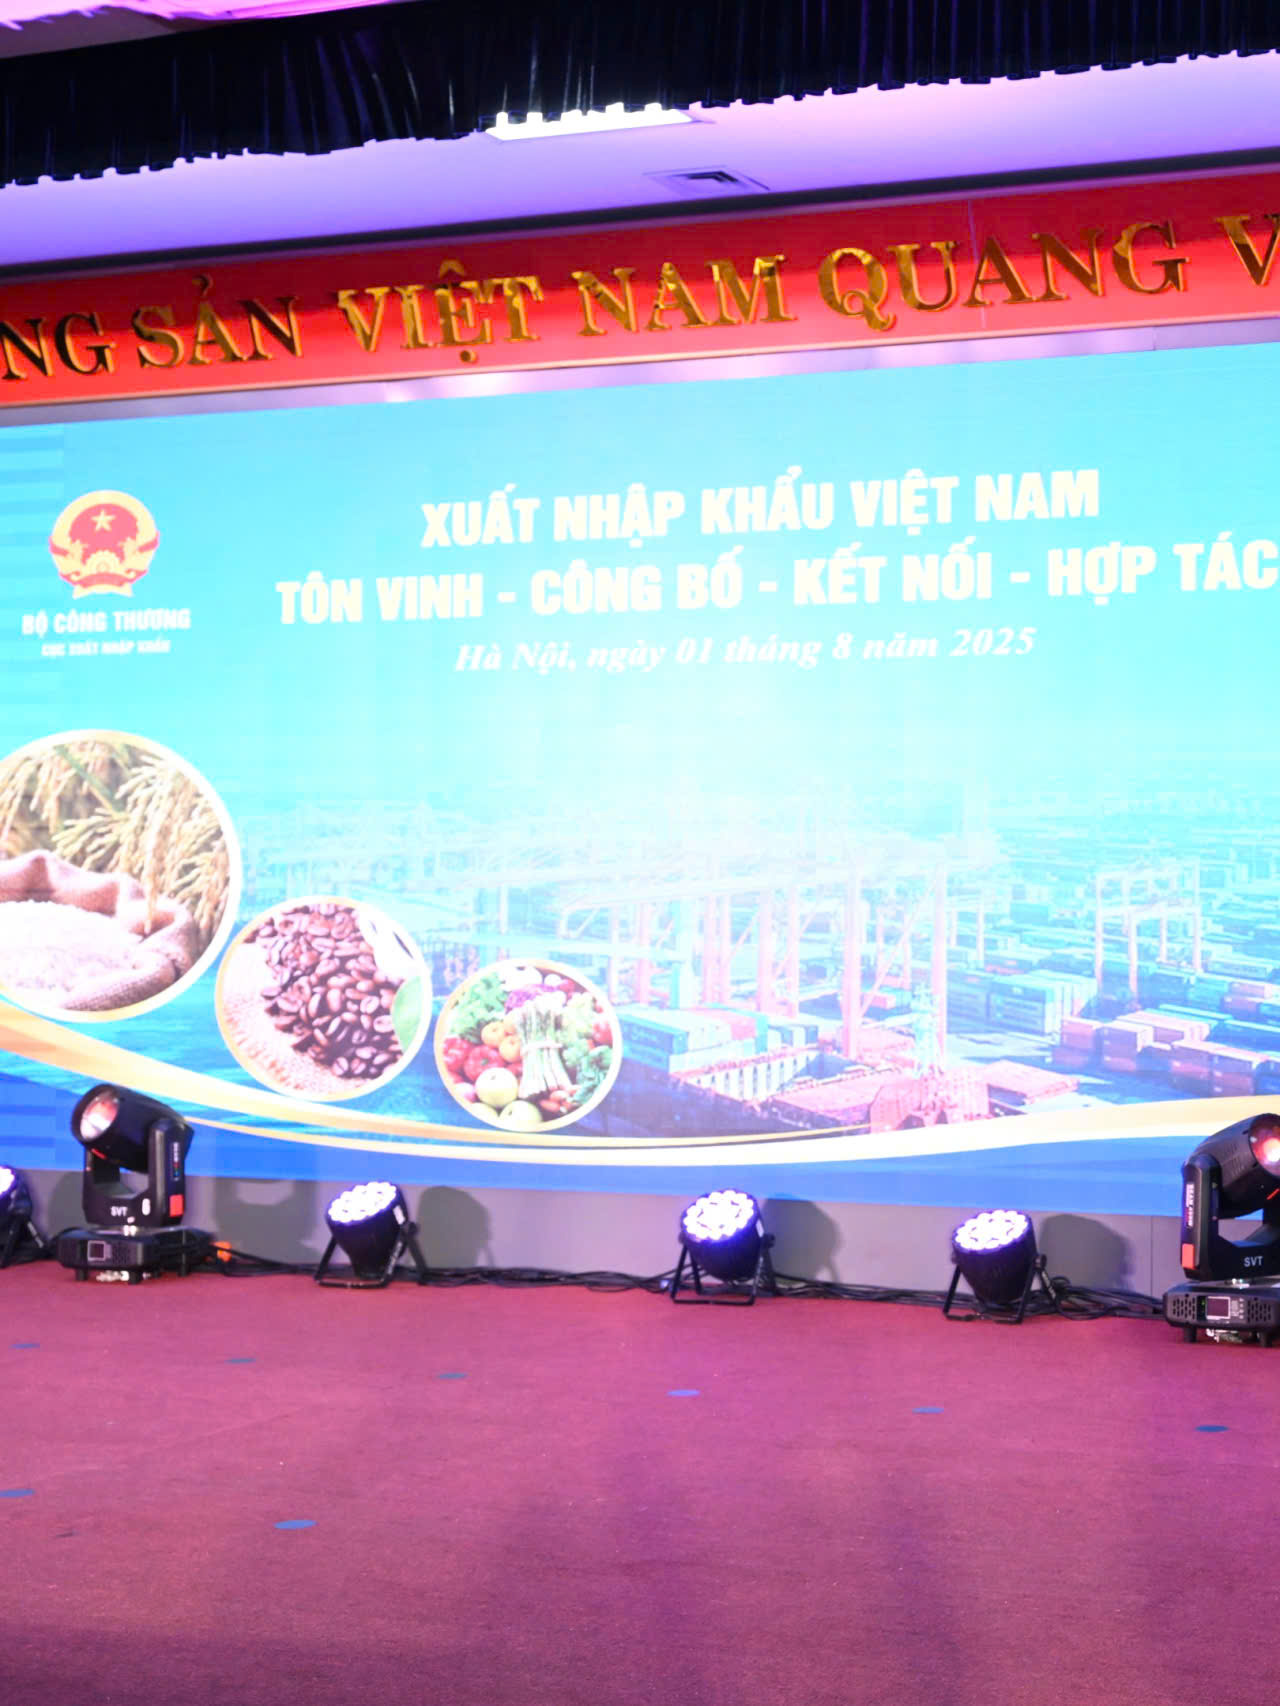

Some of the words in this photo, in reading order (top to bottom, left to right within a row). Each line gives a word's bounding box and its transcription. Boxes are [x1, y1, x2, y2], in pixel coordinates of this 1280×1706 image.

[134, 273, 303, 369] SẢN
[337, 258, 543, 364] VIỆT
[571, 253, 797, 337] NAM
[816, 218, 1191, 332] QUANG
[420, 482, 540, 548] XUẤT
[553, 481, 686, 548] NHẬP
[701, 464, 835, 536] KHẨU
[850, 467, 960, 536] VIỆT
[975, 468, 1100, 522] NAM
[275, 570, 363, 625] TÔN
[376, 573, 484, 621] VINH
[497, 591, 517, 603] -
[530, 558, 663, 616] CÔNG
[676, 545, 745, 610] BỐ
[758, 579, 778, 592] -
[793, 541, 888, 606] KẾT
[902, 535, 993, 602] NỐI
[1009, 571, 1031, 584] -
[1047, 540, 1157, 606] HỢP
[1172, 530, 1280, 592] TÁC
[53, 608, 108, 633] CÔNG
[455, 642, 502, 672] Hà
[511, 639, 577, 675] Nội,
[585, 639, 667, 673] ngày
[675, 635, 714, 664] 01
[722, 632, 824, 671] tháng
[831, 631, 855, 660] 8
[862, 630, 939, 660] năm
[949, 626, 1038, 658] 2025
[1244, 1256, 1263, 1267] SVT
